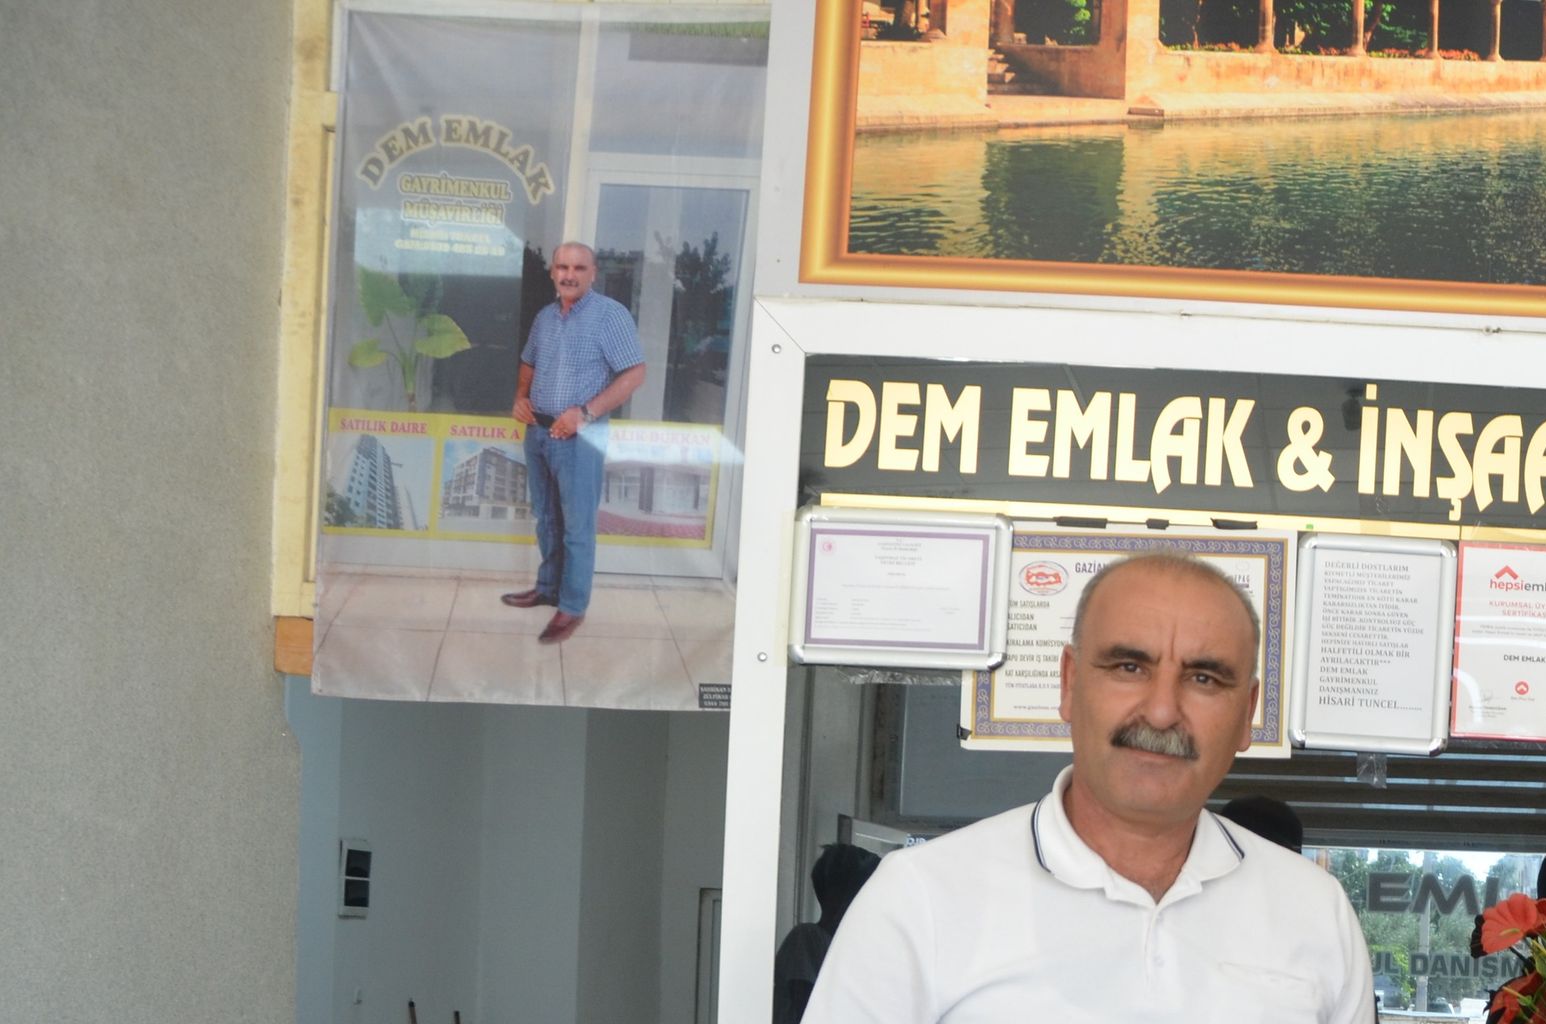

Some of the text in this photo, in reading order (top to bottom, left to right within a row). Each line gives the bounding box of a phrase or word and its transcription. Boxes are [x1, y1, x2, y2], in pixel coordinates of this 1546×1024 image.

[359, 118, 553, 201] DEM EMLAK
[400, 172, 509, 200] GAYRİMENKUL
[340, 417, 387, 433] SATILIK
[450, 425, 507, 440] SATILIK
[824, 379, 981, 474] DEM
[1007, 388, 1255, 494] EMLAK
[1276, 406, 1336, 492] &
[1503, 654, 1520, 662] DEM
[1320, 666, 1369, 676] DEM EMLAK
